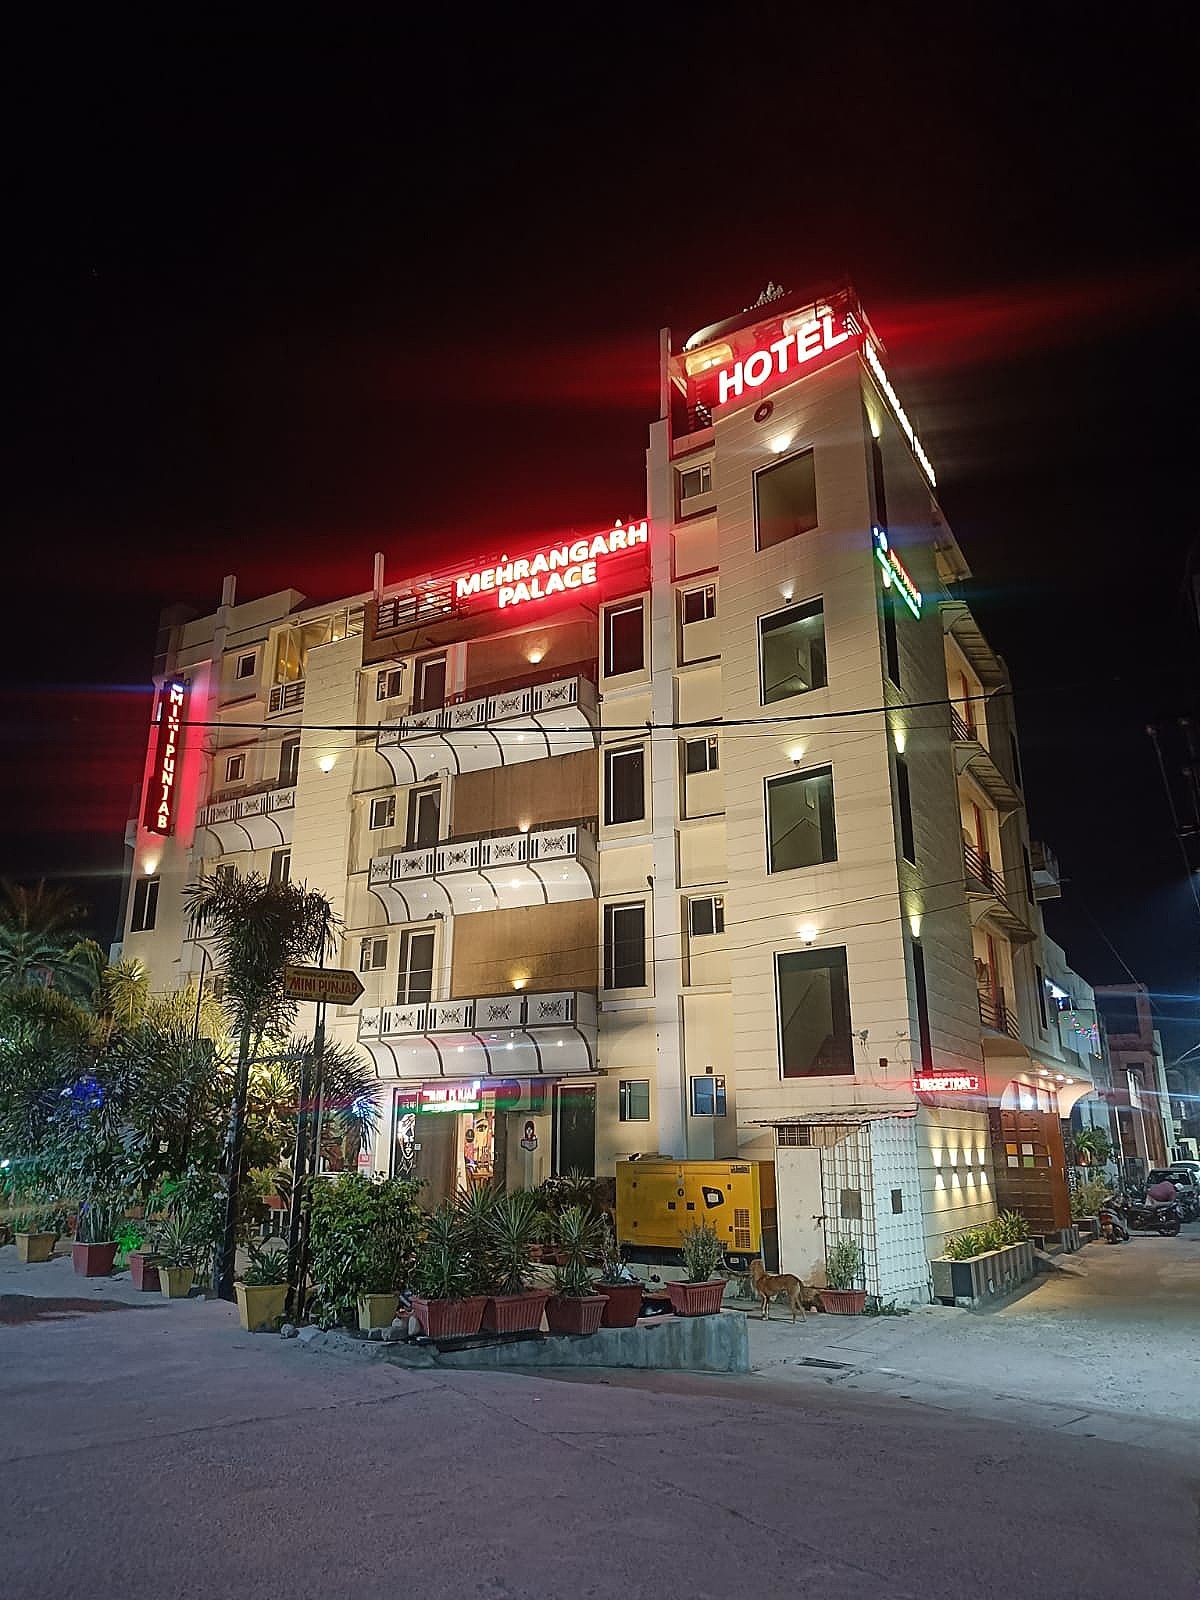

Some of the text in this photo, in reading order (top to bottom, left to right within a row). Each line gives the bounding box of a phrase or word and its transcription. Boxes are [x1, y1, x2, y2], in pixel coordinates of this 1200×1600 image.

[718, 315, 849, 403] HOTEL
[456, 521, 648, 598] MEHRANGARH
[498, 561, 597, 609] PALACE
[157, 689, 184, 829] MINI PUNJAB
[289, 976, 358, 994] MINI PUNJAB
